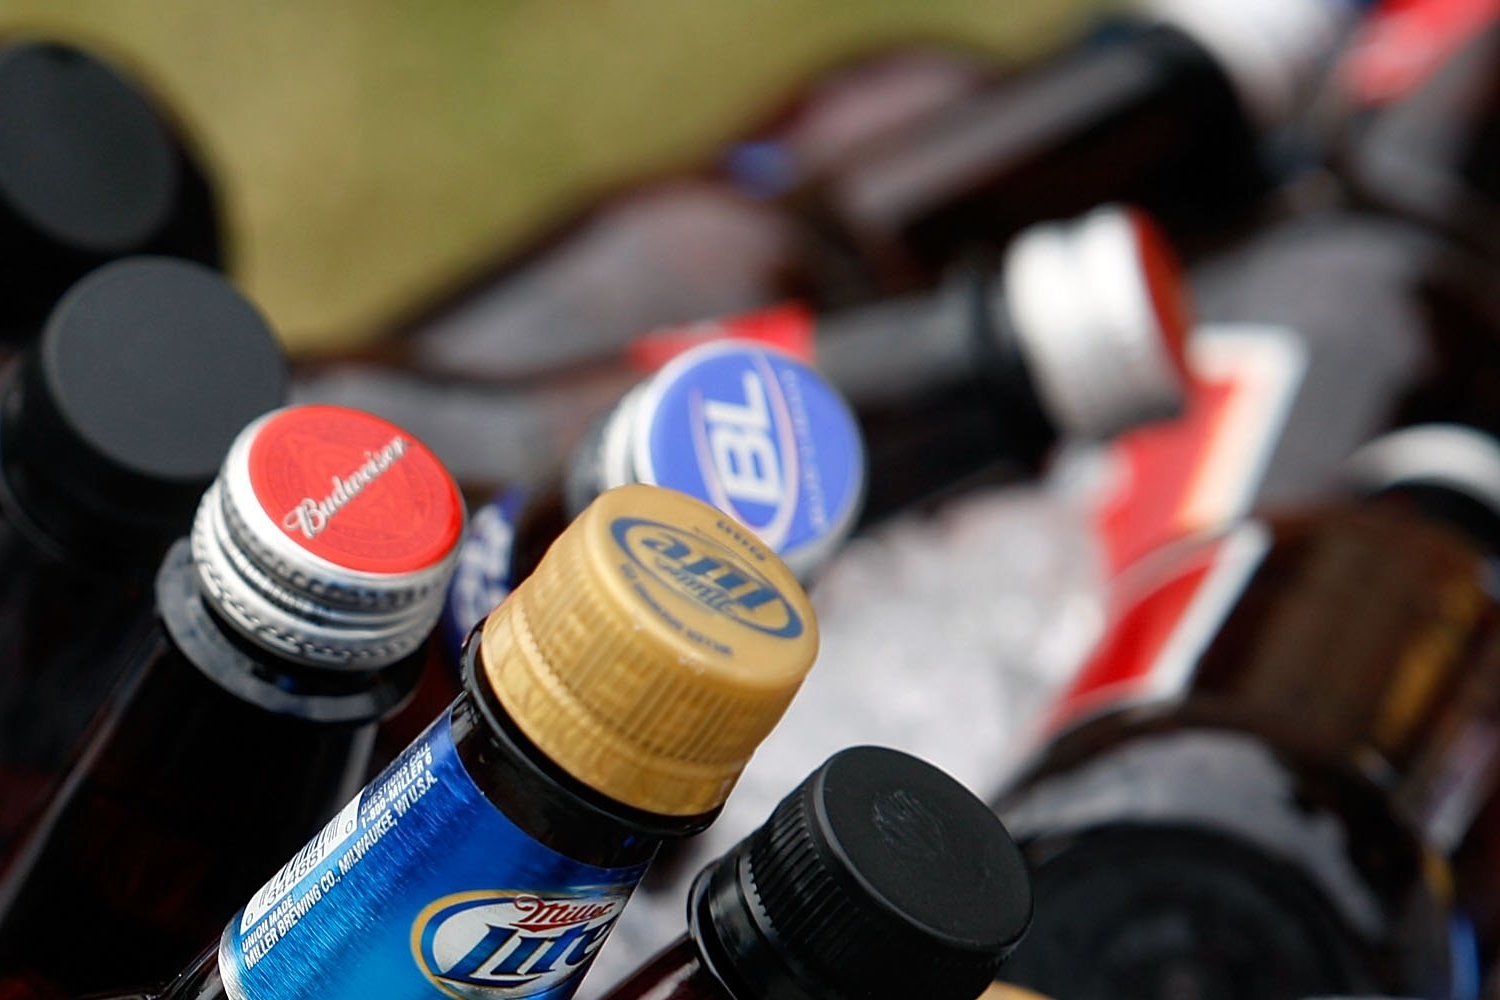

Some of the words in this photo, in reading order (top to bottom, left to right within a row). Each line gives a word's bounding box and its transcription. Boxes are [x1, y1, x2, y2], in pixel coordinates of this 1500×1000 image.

[702, 370, 786, 505] BL
[283, 436, 405, 541] Budweiser
[640, 538, 780, 612] Lite
[360, 762, 409, 816] QUESTIONS
[360, 762, 425, 830] 1-800-MILLER
[243, 929, 281, 972] MILLER
[277, 886, 322, 935] BREWING
[320, 867, 342, 892] CO.,
[337, 805, 399, 877] MILWAUKEE,
[408, 769, 438, 801] U.S.A.
[267, 846, 327, 908] 344881
[241, 920, 269, 952] UNION
[268, 893, 295, 926] MADE
[512, 894, 614, 934] Miller
